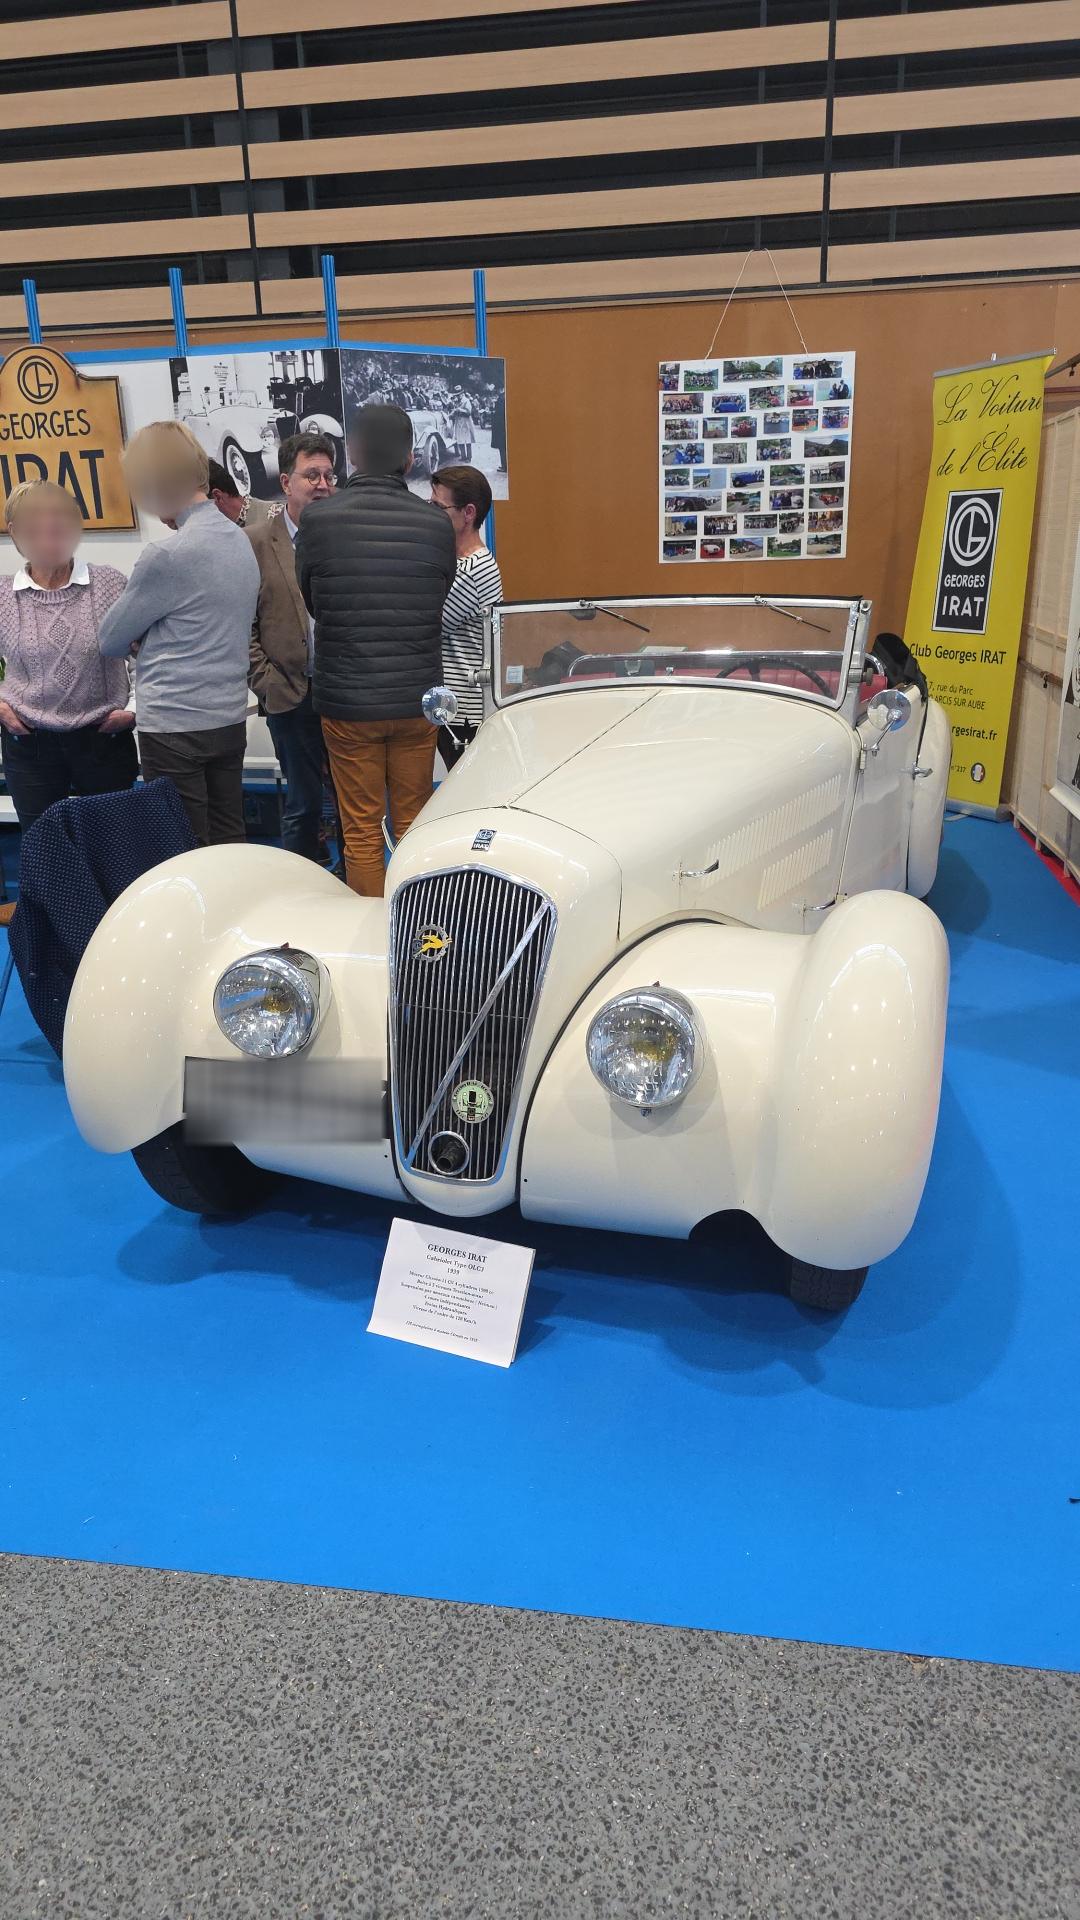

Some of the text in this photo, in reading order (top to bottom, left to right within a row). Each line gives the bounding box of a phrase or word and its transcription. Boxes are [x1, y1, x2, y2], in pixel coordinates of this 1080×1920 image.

[937, 382, 973, 426] La
[0, 408, 92, 441] GEORGES
[937, 448, 954, 477] de
[944, 574, 986, 588] GEORGES
[941, 595, 985, 617] IRAT
[909, 643, 1007, 665] Club Georges IRAT
[936, 684, 948, 692] rue
[949, 683, 957, 693] du
[959, 685, 974, 696] Parc
[953, 696, 967, 707] SUR
[967, 699, 987, 711] AUBE
[951, 726, 998, 741] rgesirat.fr
[427, 1243, 488, 1263] GEORGES IRAT
